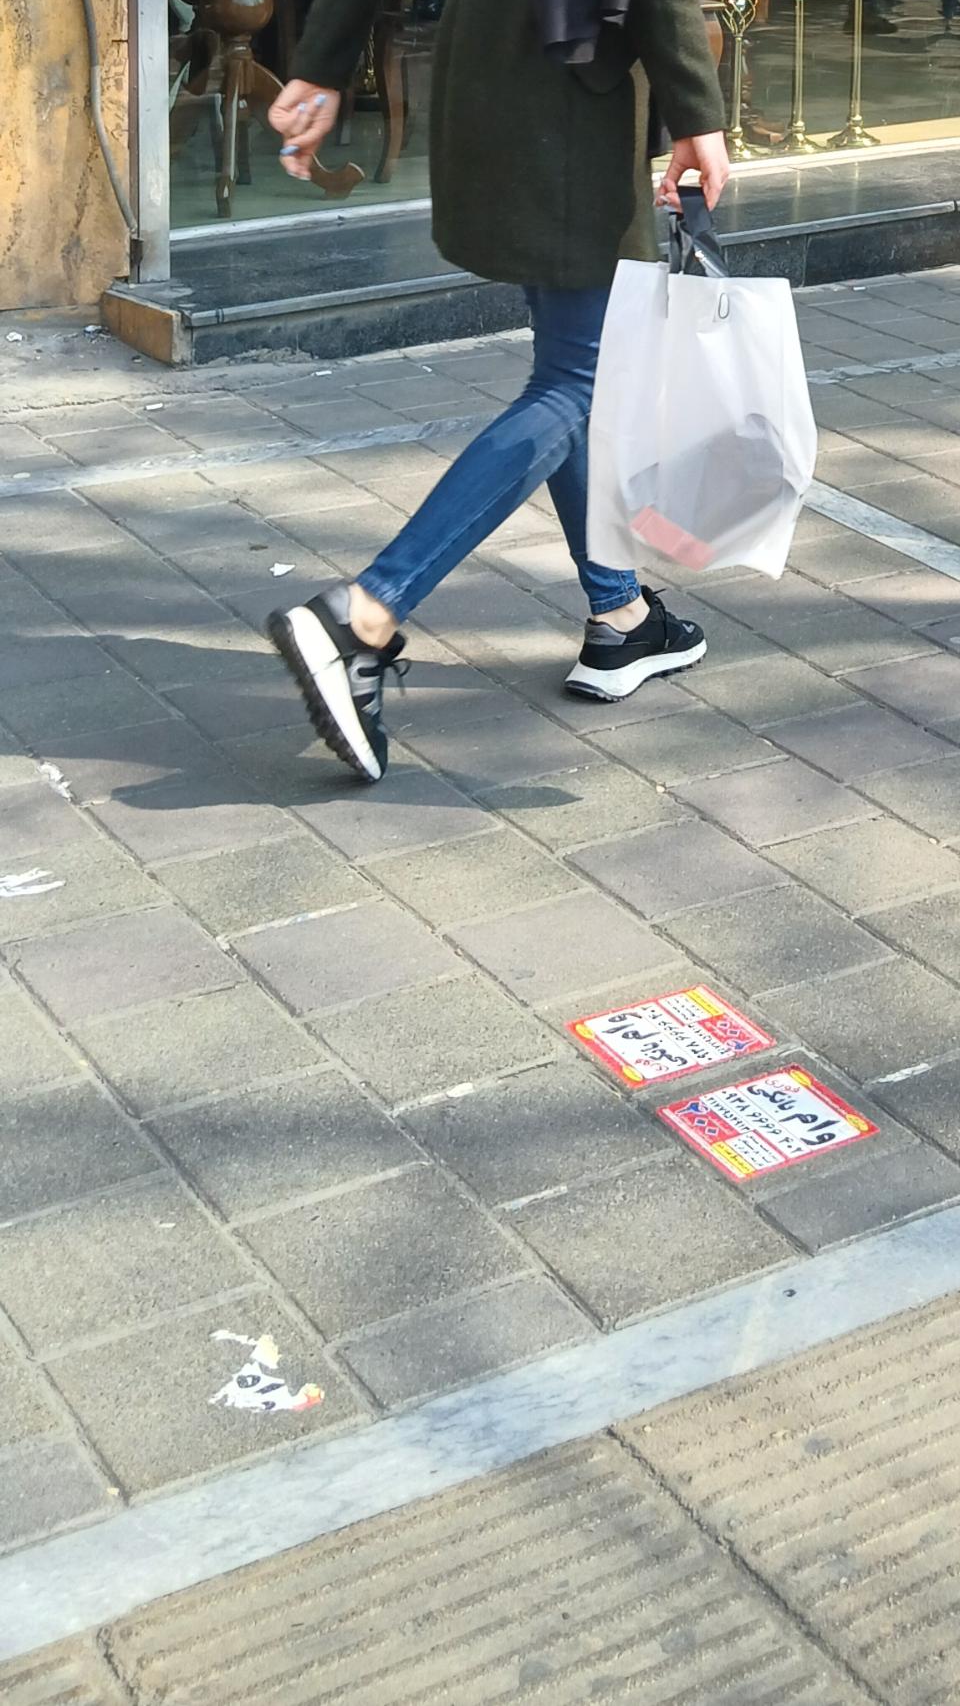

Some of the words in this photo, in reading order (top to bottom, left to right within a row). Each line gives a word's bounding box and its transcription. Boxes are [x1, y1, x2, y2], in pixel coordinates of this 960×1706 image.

[602, 1012, 661, 1040] وام
[640, 1039, 688, 1067] بانکی
[747, 1084, 796, 1113] بانکی
[765, 1079, 801, 1093] فوری
[722, 1091, 750, 1112] ۰۹۳۸
[746, 1111, 783, 1134] ۶۶۶۶
[778, 1136, 804, 1153] ۴۰۲
[779, 1113, 841, 1145] وام
